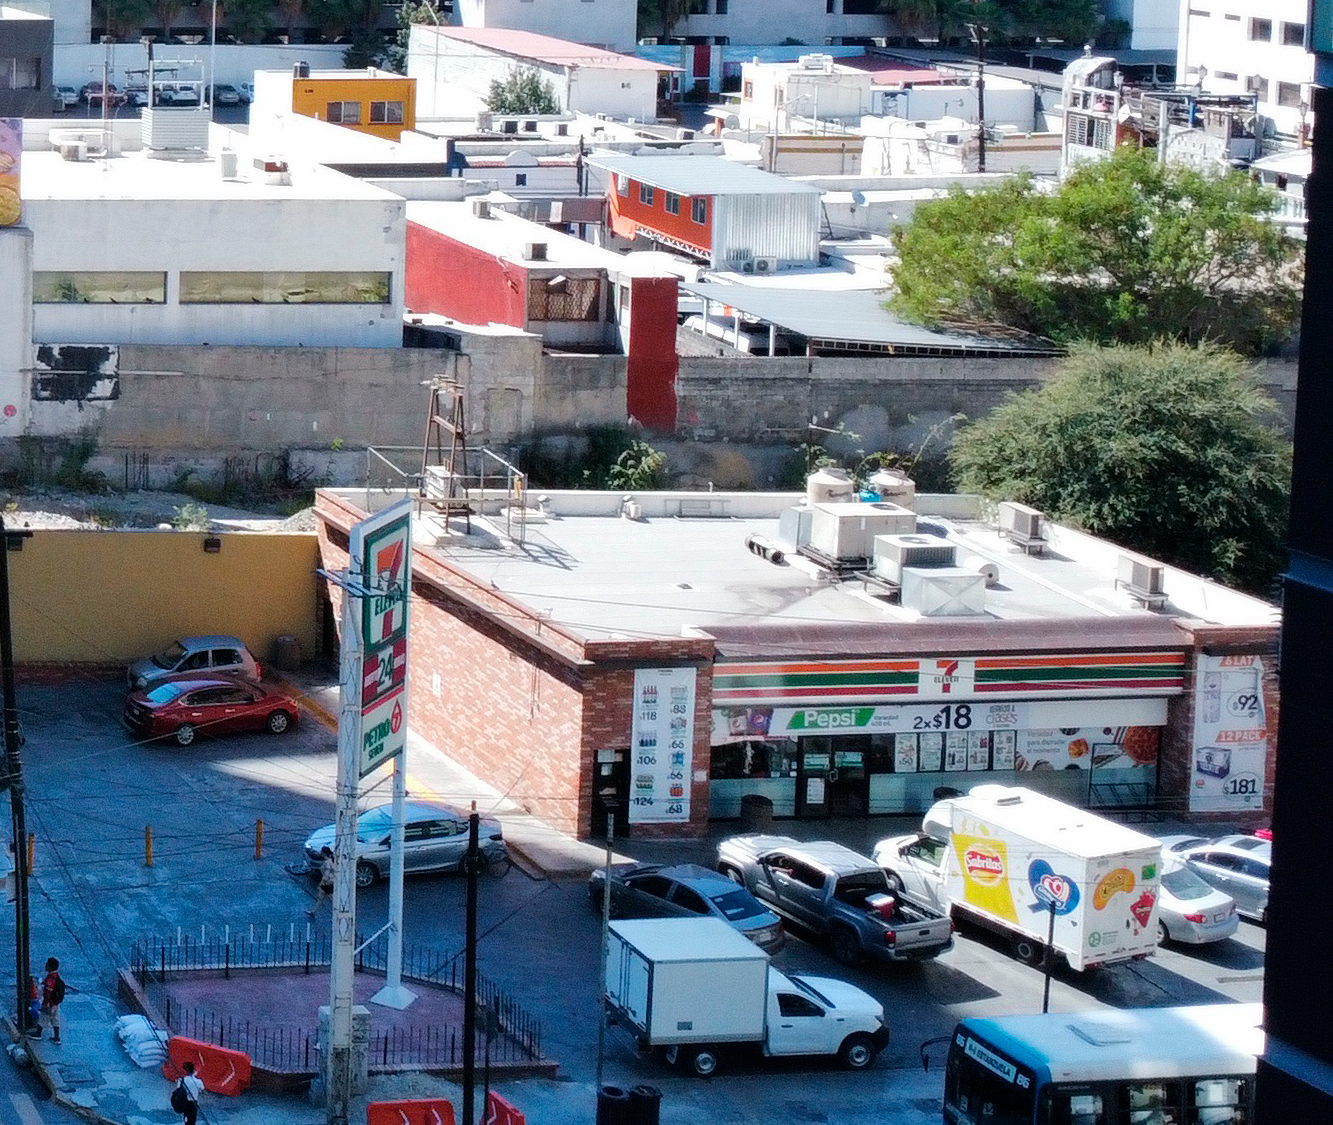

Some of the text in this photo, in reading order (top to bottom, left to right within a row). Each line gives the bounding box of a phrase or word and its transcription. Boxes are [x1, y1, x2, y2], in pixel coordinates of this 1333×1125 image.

[378, 652, 394, 690] 24
[936, 660, 958, 694] 7
[363, 718, 390, 752] PETRO
[804, 709, 856, 728] Pepsi
[1220, 730, 1260, 741] 12 PACK
